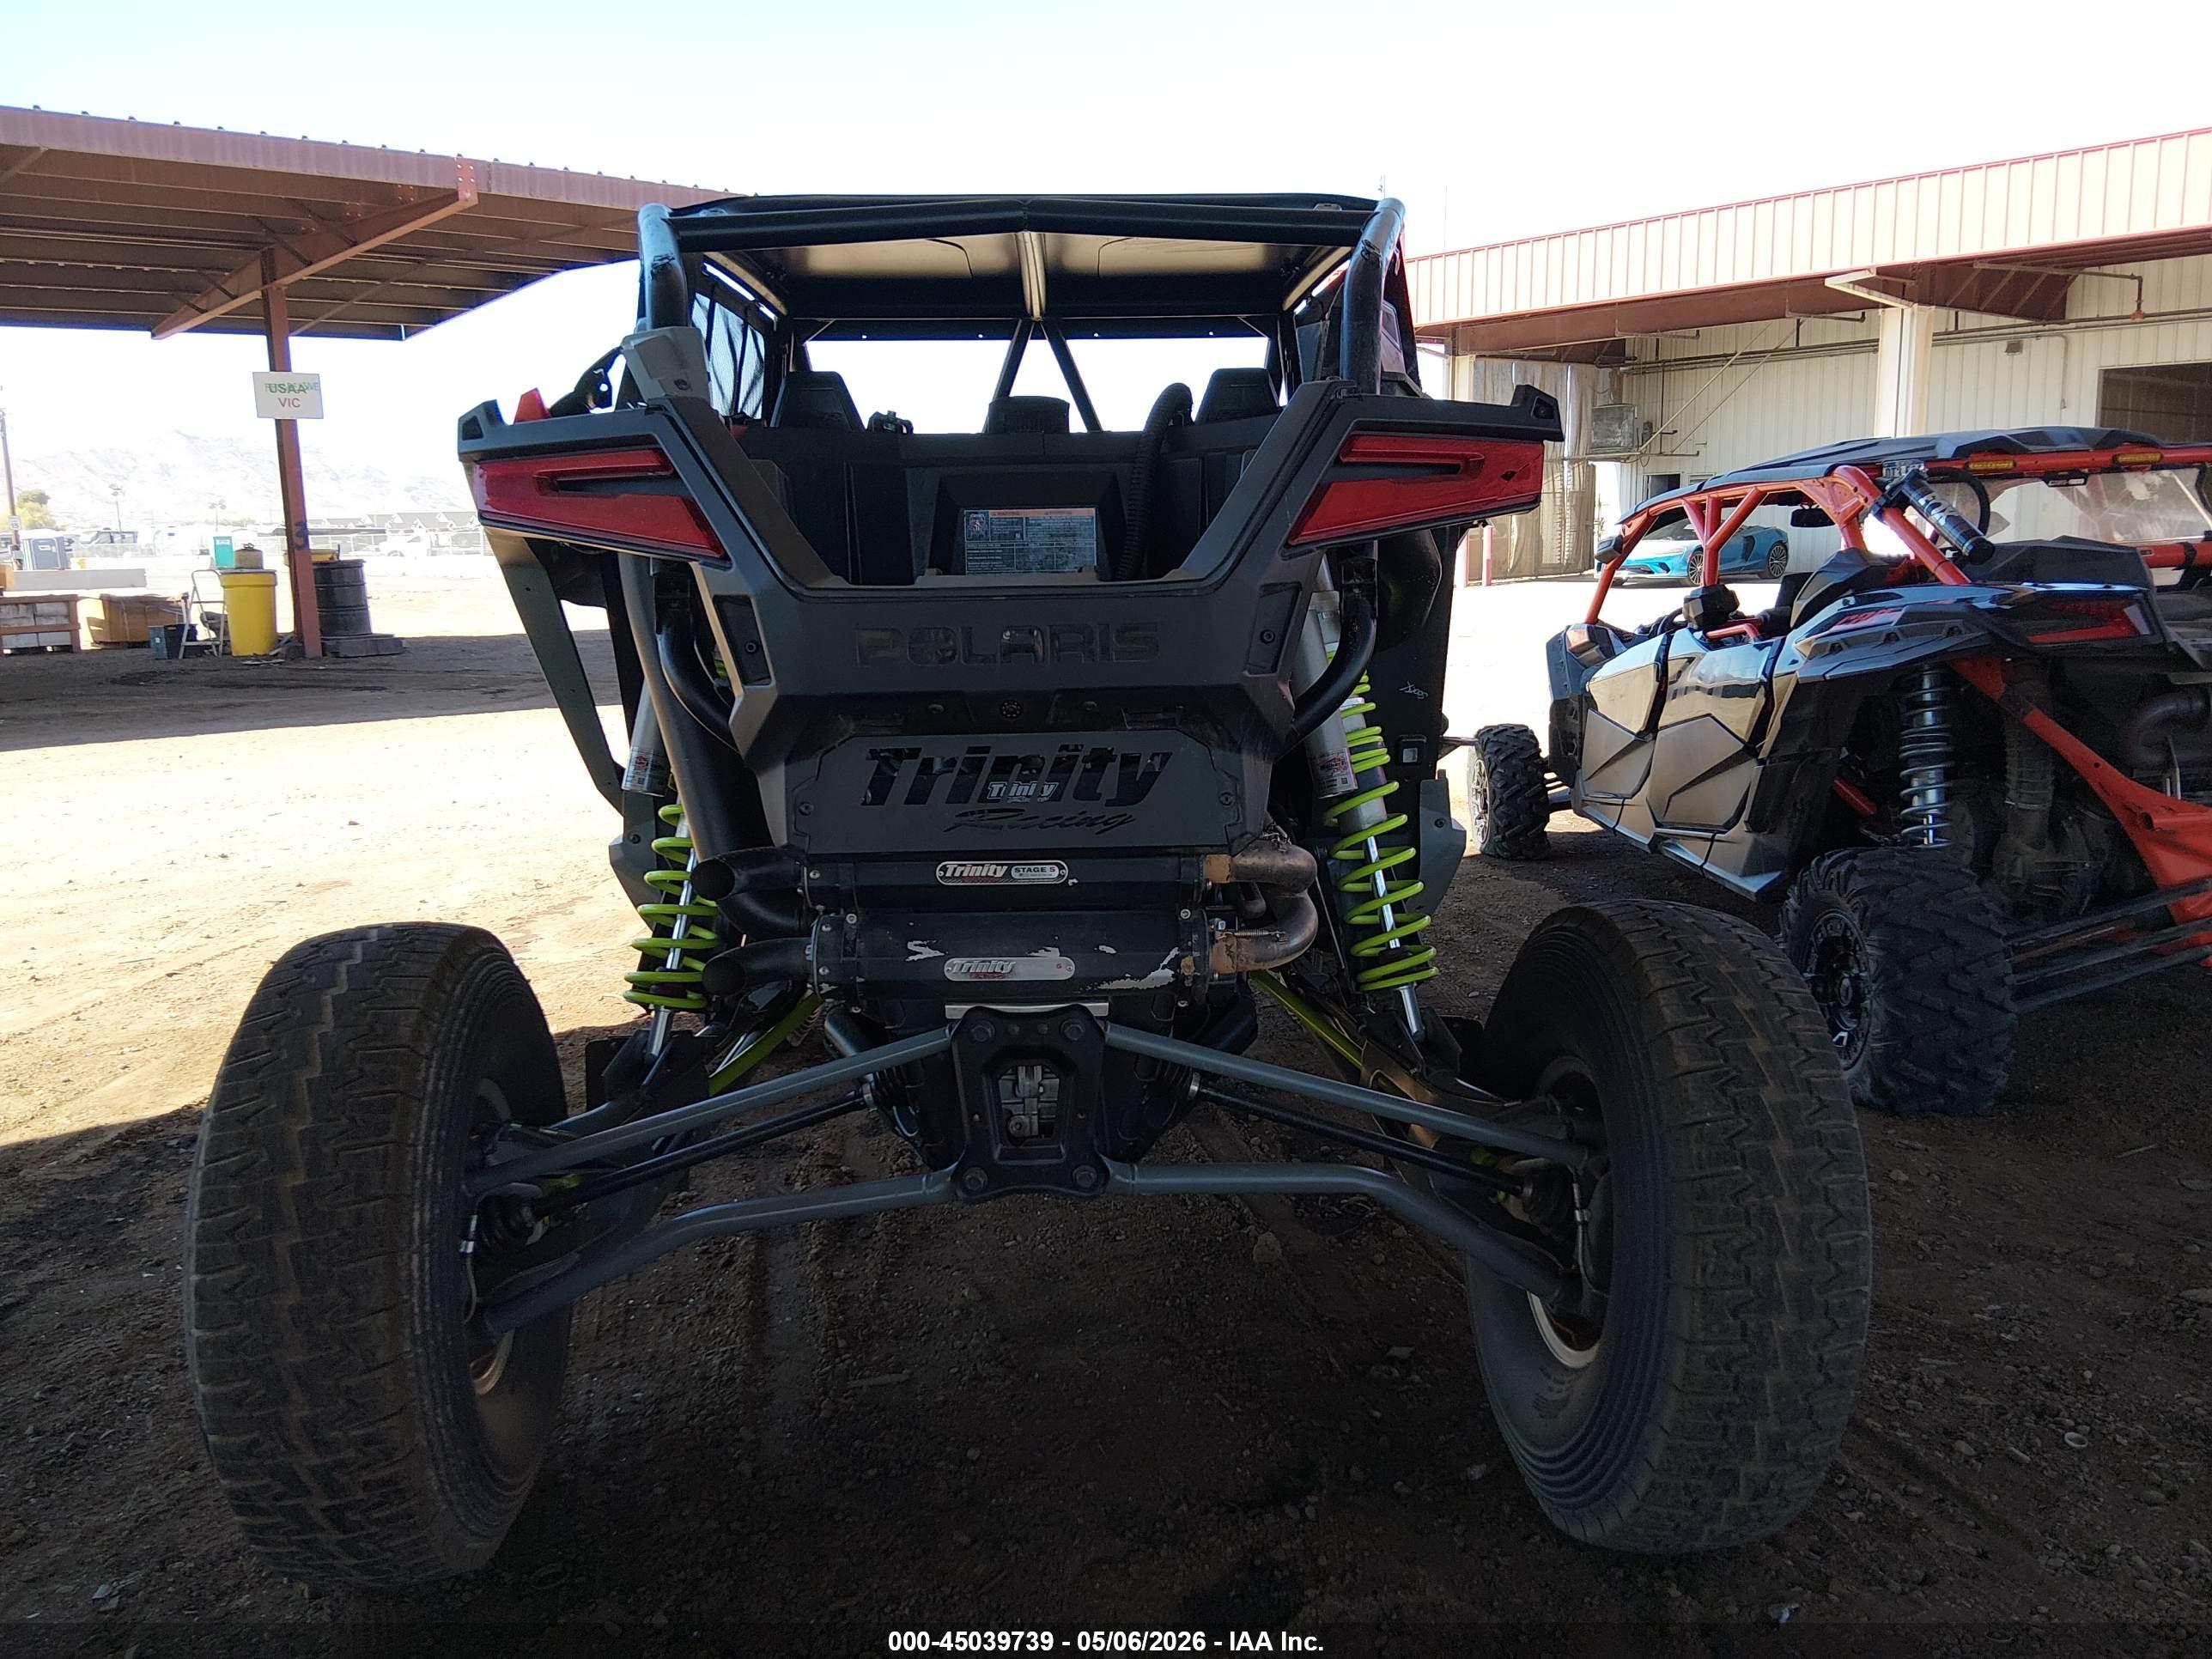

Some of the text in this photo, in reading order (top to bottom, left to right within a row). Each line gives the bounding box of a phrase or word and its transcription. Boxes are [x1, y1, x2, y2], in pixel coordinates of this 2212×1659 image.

[277, 397, 301, 408] VIC
[854, 623, 1160, 667] POLARIS
[860, 744, 1173, 807] Trinity
[987, 781, 1059, 800] Triniy
[945, 863, 1009, 878] Trinity
[1014, 866, 1048, 874] STAGE
[952, 959, 1017, 974] Trinity
